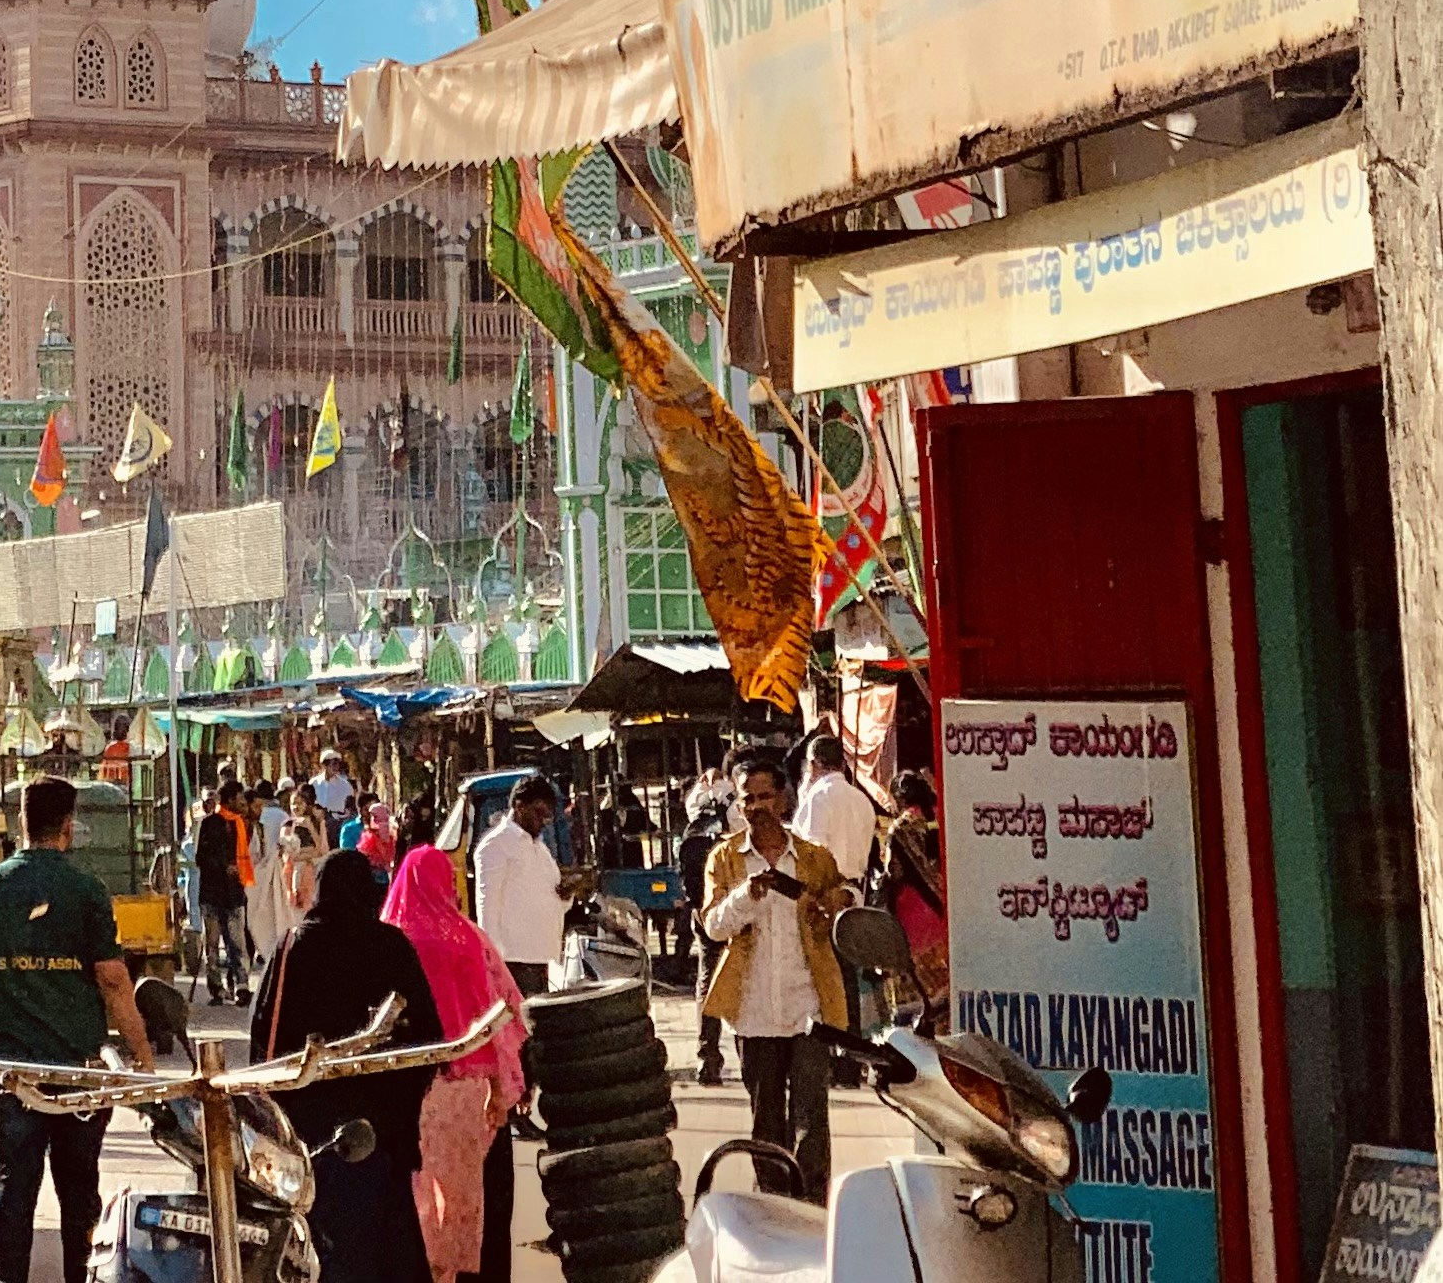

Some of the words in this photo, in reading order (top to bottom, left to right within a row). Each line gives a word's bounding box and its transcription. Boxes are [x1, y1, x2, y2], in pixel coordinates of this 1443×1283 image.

[1167, 5, 1219, 51] AKKIPET
[959, 990, 1043, 1067] USTAD
[1048, 992, 1199, 1075] KAYANGADI
[1081, 1108, 1213, 1189] MASSAGE
[1076, 1220, 1154, 1283] TUTE
